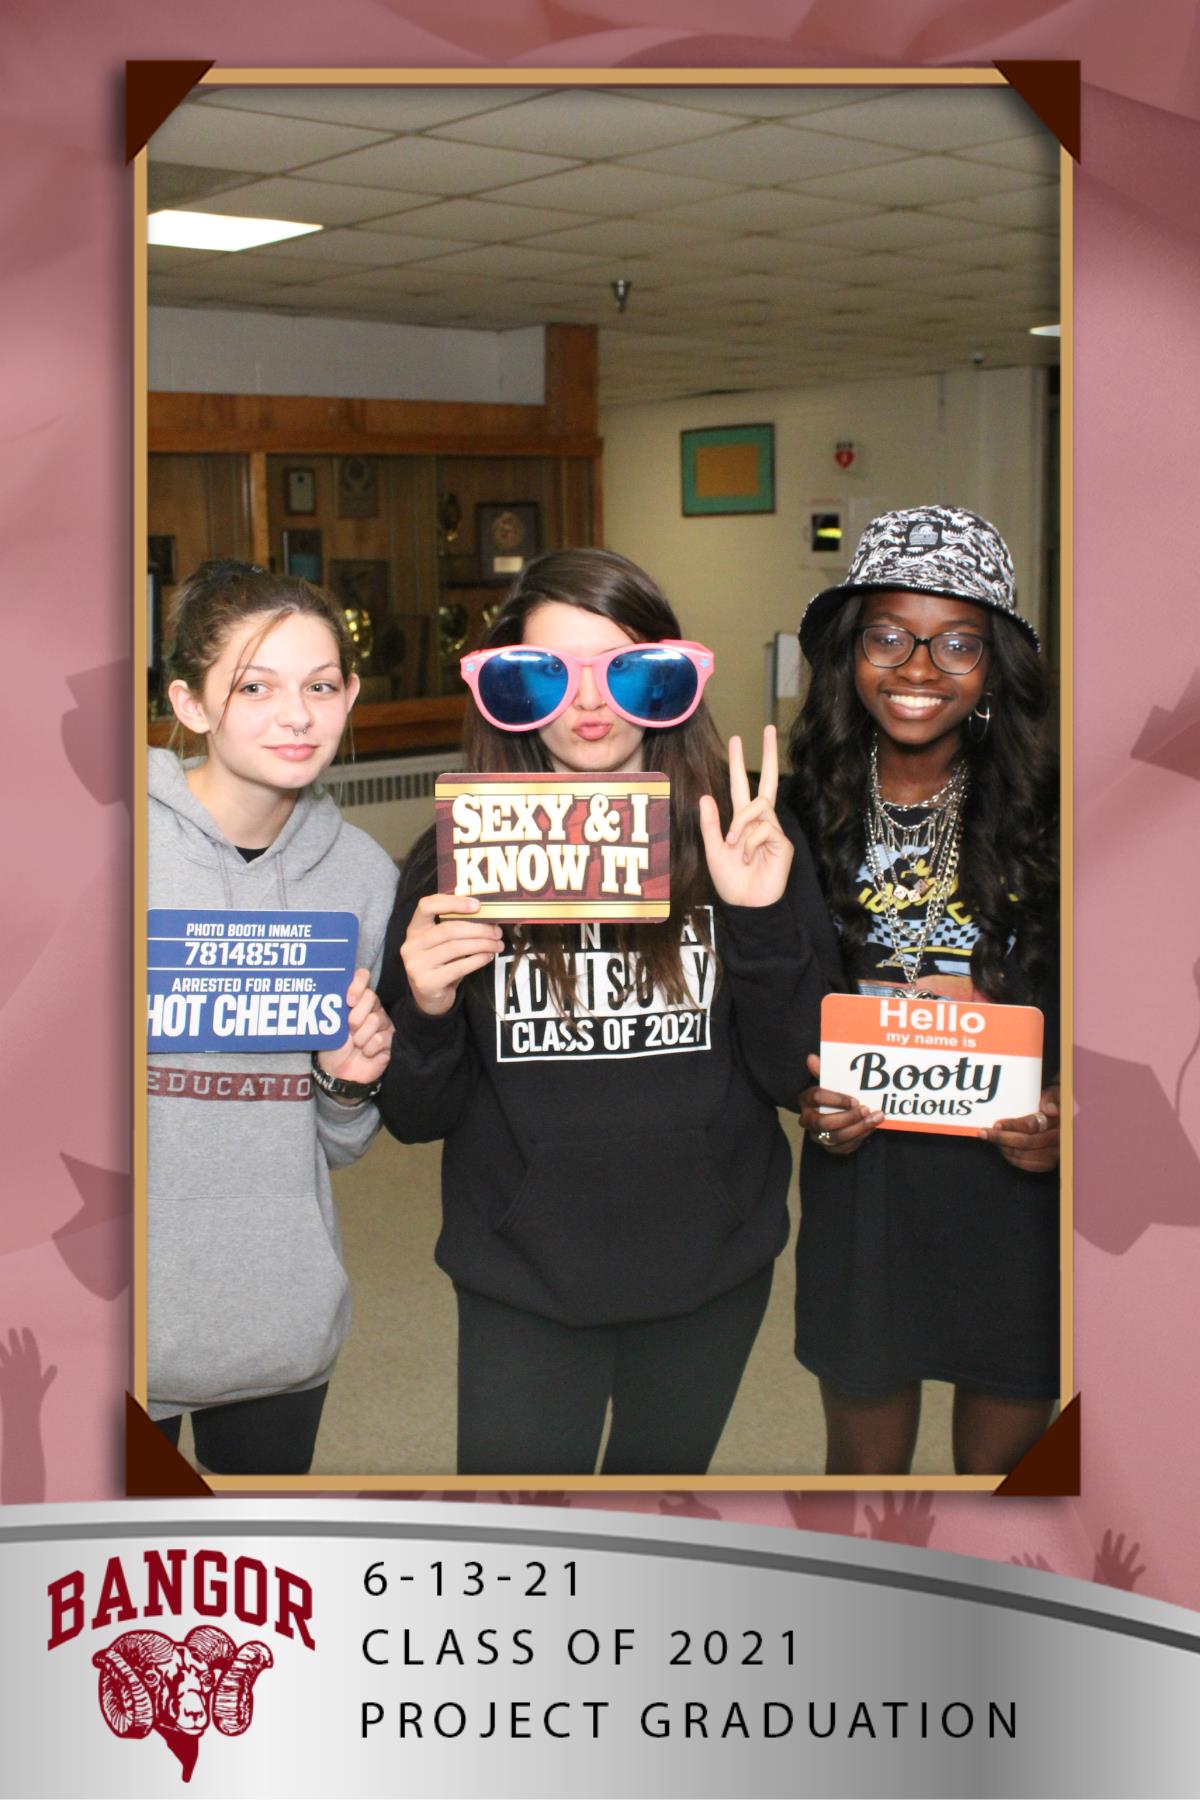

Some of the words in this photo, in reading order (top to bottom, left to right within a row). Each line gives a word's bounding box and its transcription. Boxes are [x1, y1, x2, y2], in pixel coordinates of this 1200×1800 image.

[452, 793, 573, 844] SEXY
[584, 793, 620, 843] &
[630, 793, 649, 843] I
[453, 844, 590, 896] KNOW
[601, 846, 649, 896] IT
[186, 923, 224, 937] PHOTO
[227, 924, 265, 938] BOOTH
[268, 924, 312, 938] INMATE
[184, 941, 307, 967] 78148510
[171, 977, 242, 993] ARRESTED
[245, 978, 271, 993] FOR
[274, 978, 317, 993] BEING:
[212, 993, 342, 1037] CHEEKS
[880, 999, 986, 1034] Hello
[512, 1020, 595, 1054] CLASS
[603, 1017, 638, 1050] OF
[645, 1012, 701, 1048] 2021
[886, 1032, 910, 1046] my
[914, 1034, 958, 1047] name
[962, 1036, 977, 1048] is
[850, 1052, 1002, 1104] Booty
[880, 1093, 975, 1116] licious
